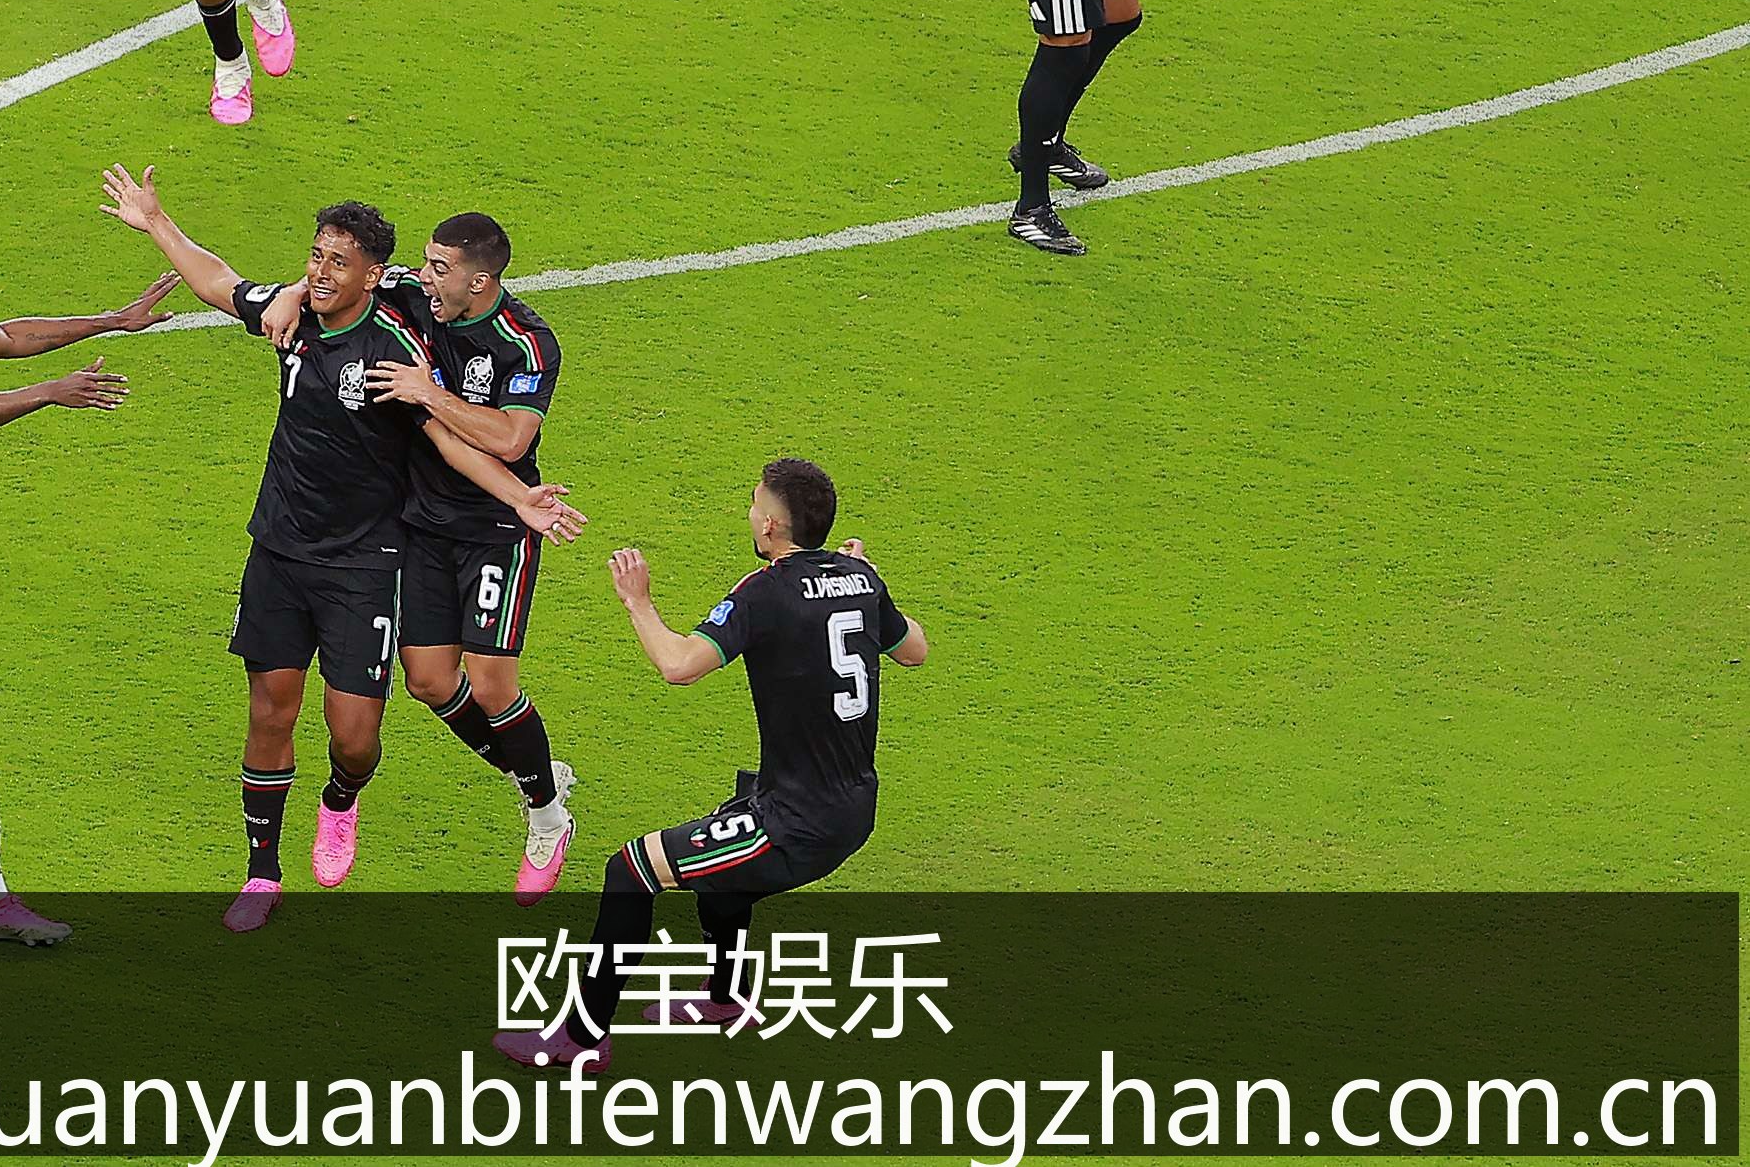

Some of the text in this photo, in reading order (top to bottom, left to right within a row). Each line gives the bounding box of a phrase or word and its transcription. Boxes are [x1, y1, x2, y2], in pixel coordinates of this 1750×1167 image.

[285, 353, 302, 399] 7
[477, 564, 504, 611] 6
[373, 616, 392, 662] 7
[827, 609, 869, 722] 5
[710, 814, 756, 842] 5
